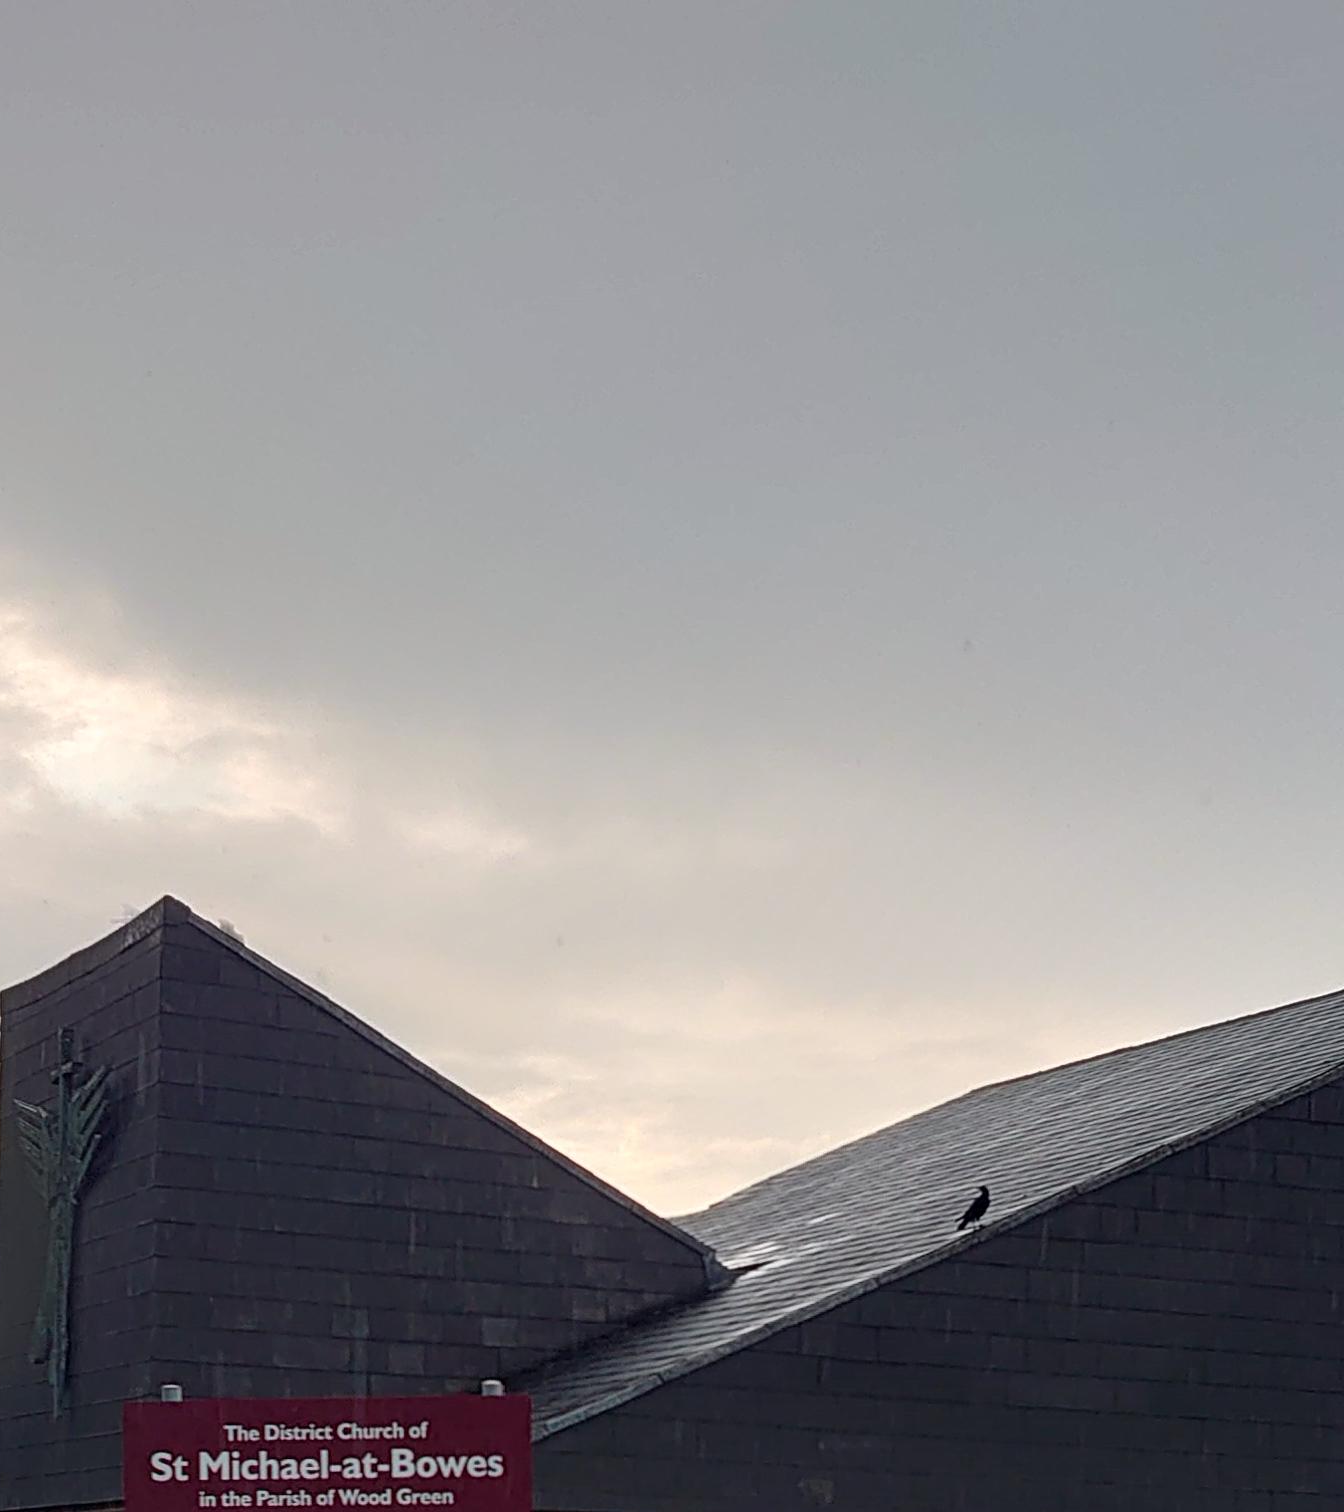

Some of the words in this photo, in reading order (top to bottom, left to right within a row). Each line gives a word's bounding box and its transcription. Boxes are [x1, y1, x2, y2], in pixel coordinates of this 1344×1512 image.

[224, 1424, 260, 1441] The
[264, 1423, 332, 1441] District
[337, 1422, 404, 1441] Church
[409, 1421, 428, 1439] of
[150, 1452, 189, 1482] St
[199, 1449, 504, 1481] Michael-at-Bowes
[199, 1491, 216, 1508] in
[221, 1490, 251, 1507] the
[256, 1490, 312, 1507] Parish
[316, 1489, 335, 1506] of
[339, 1489, 392, 1506] Wood
[396, 1489, 454, 1506] Green
